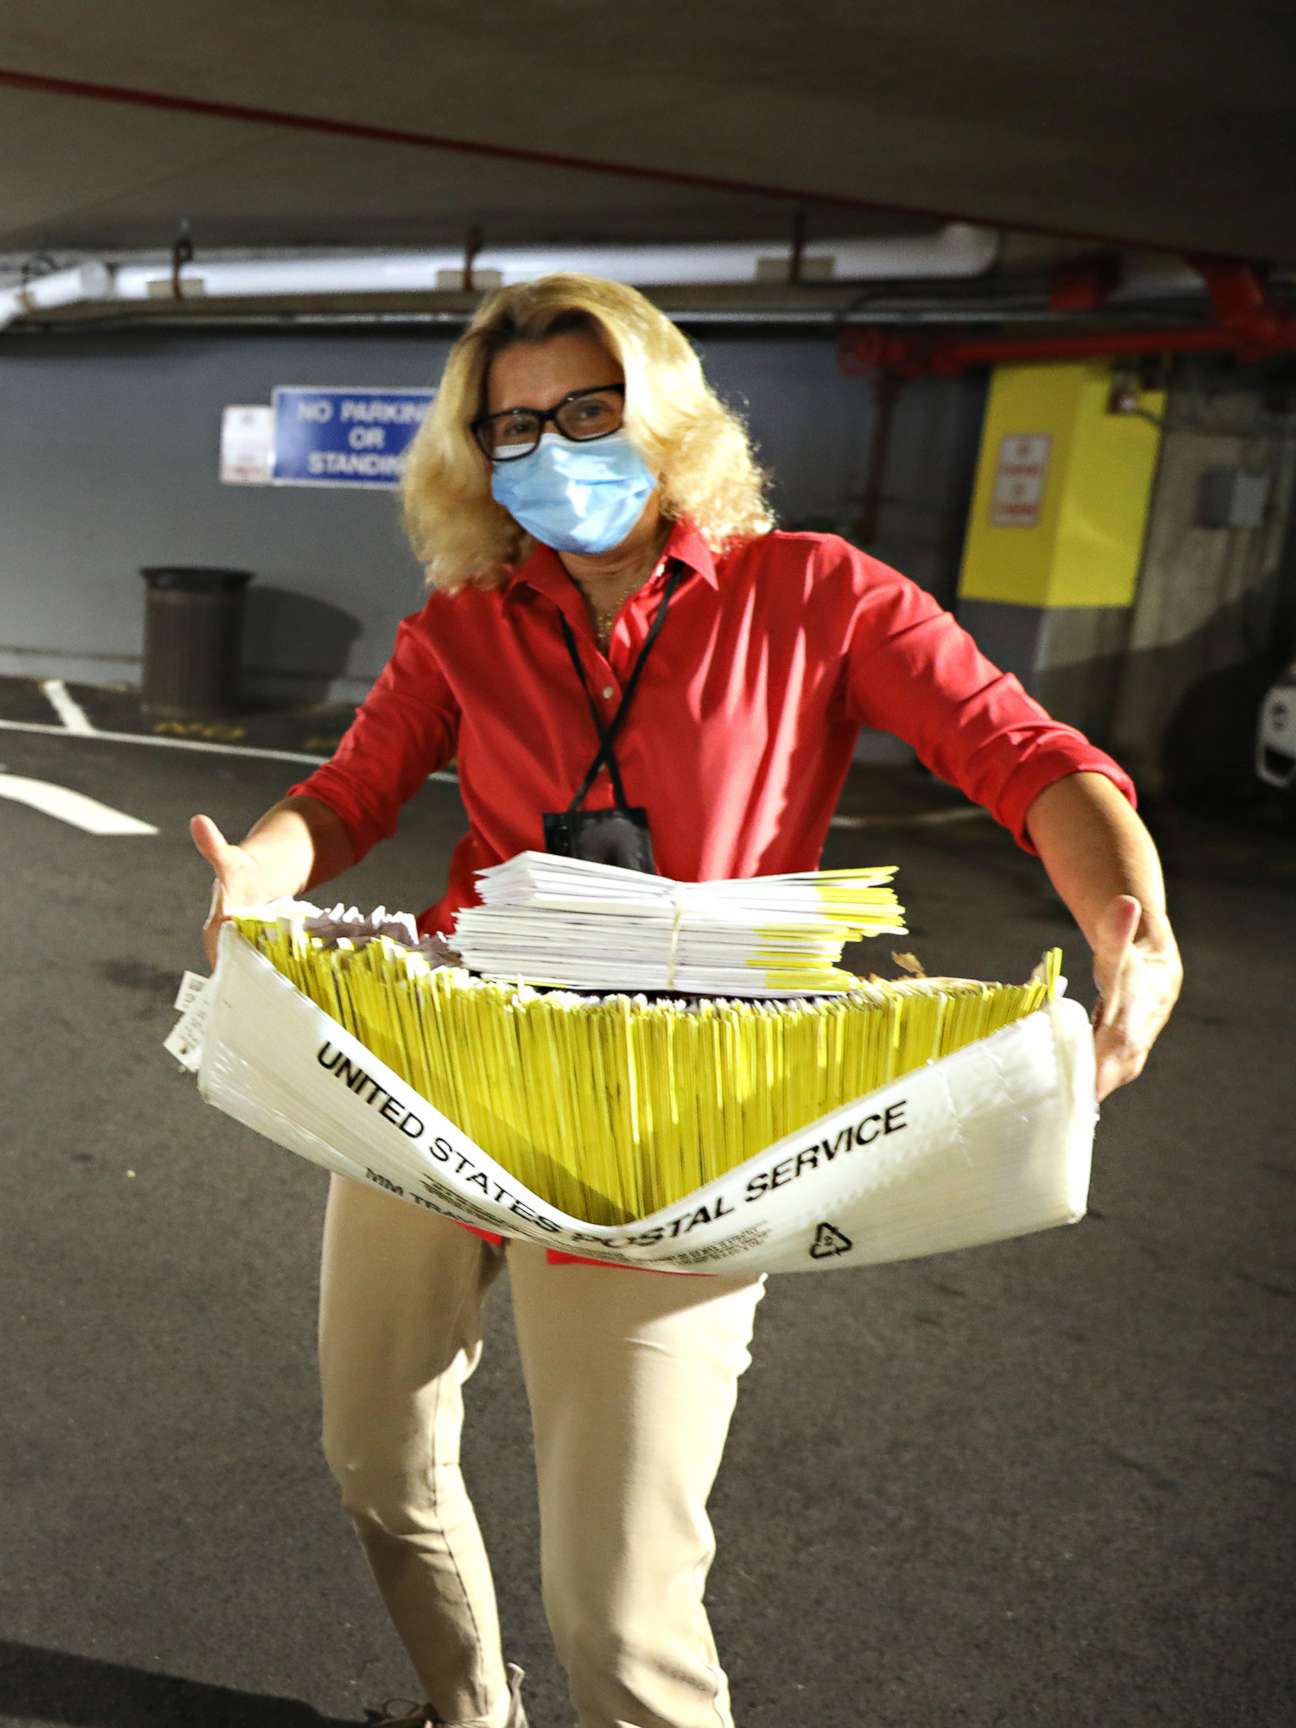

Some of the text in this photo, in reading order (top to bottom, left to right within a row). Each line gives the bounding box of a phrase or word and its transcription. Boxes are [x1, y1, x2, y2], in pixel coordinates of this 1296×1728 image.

[298, 401, 333, 424] NO
[348, 426, 386, 450] OR
[317, 1040, 425, 1139] UNITED
[429, 1137, 561, 1233] STATES
[745, 1100, 908, 1203] SERVICE
